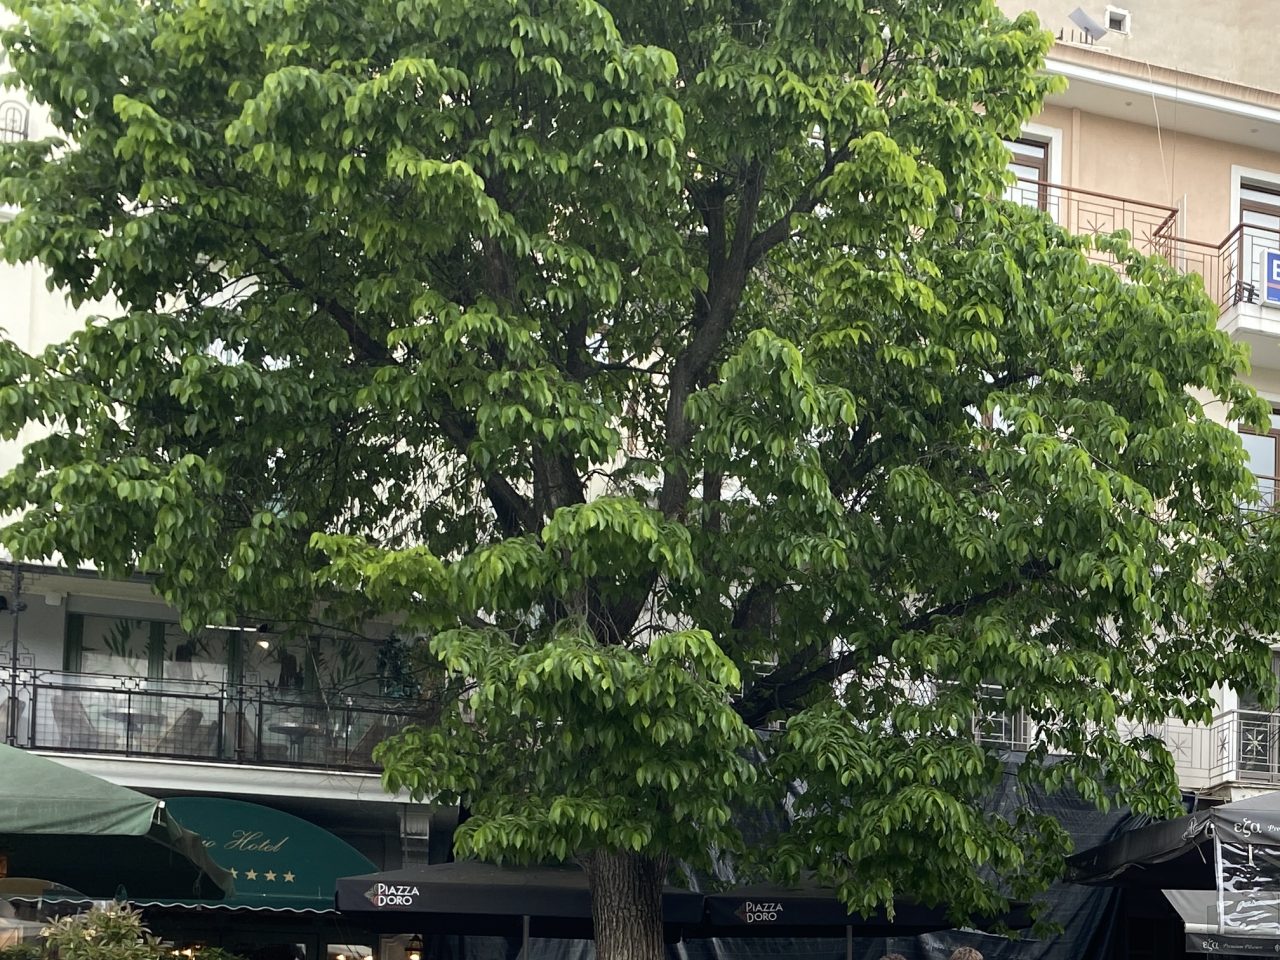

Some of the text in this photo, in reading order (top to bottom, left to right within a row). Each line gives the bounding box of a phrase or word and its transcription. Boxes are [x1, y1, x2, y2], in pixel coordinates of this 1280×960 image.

[224, 830, 290, 853] Hotel
[378, 883, 420, 897] PIAZZA
[378, 895, 413, 906] DORO
[745, 901, 784, 912] PIAZZA
[746, 912, 777, 923] DORO
